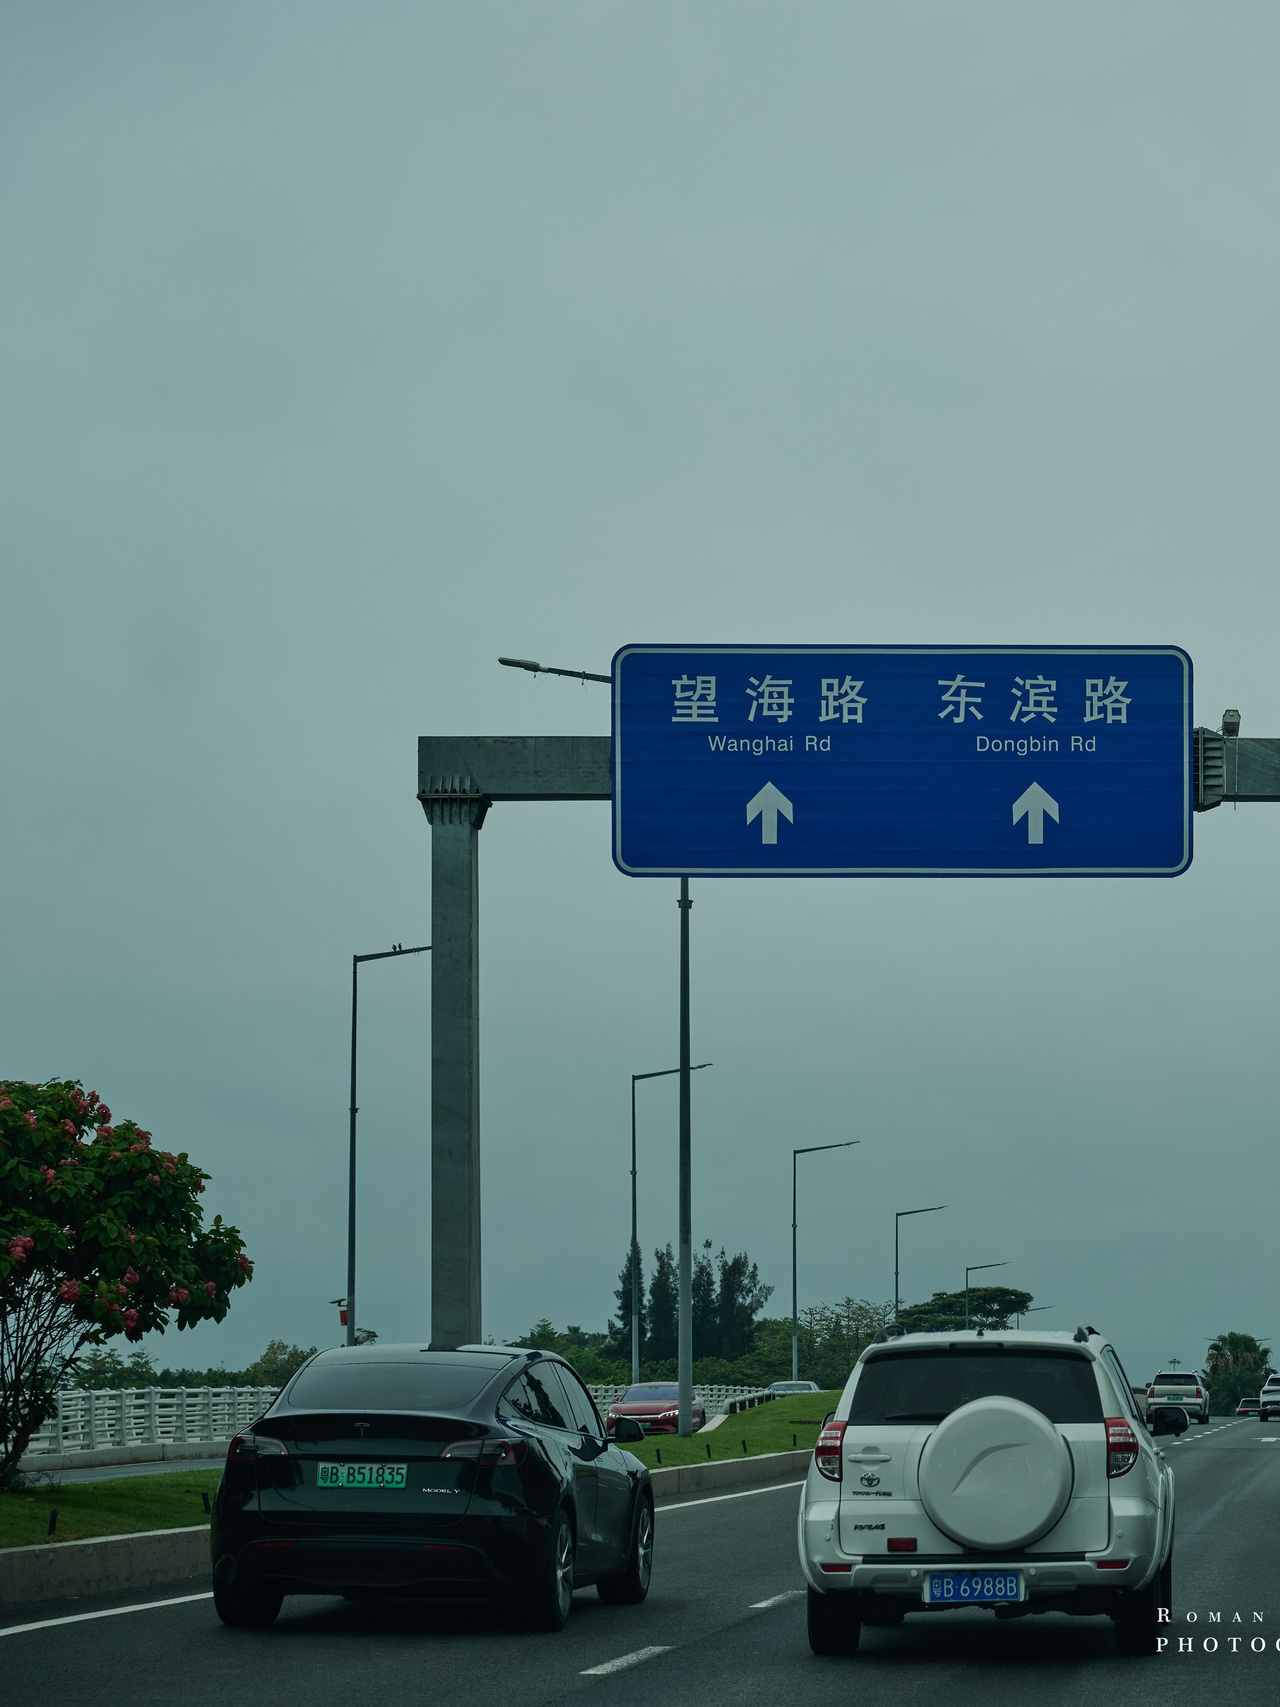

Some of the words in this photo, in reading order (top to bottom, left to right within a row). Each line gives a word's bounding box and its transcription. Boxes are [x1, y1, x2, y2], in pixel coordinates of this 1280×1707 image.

[671, 674, 868, 724] 望海路
[937, 674, 1132, 724] 东滨路
[707, 734, 795, 755] Wanghai
[804, 734, 832, 752] Rd
[976, 735, 1059, 756] Dongbin
[1070, 735, 1097, 752] Rd
[853, 1523, 886, 1531] RAV4
